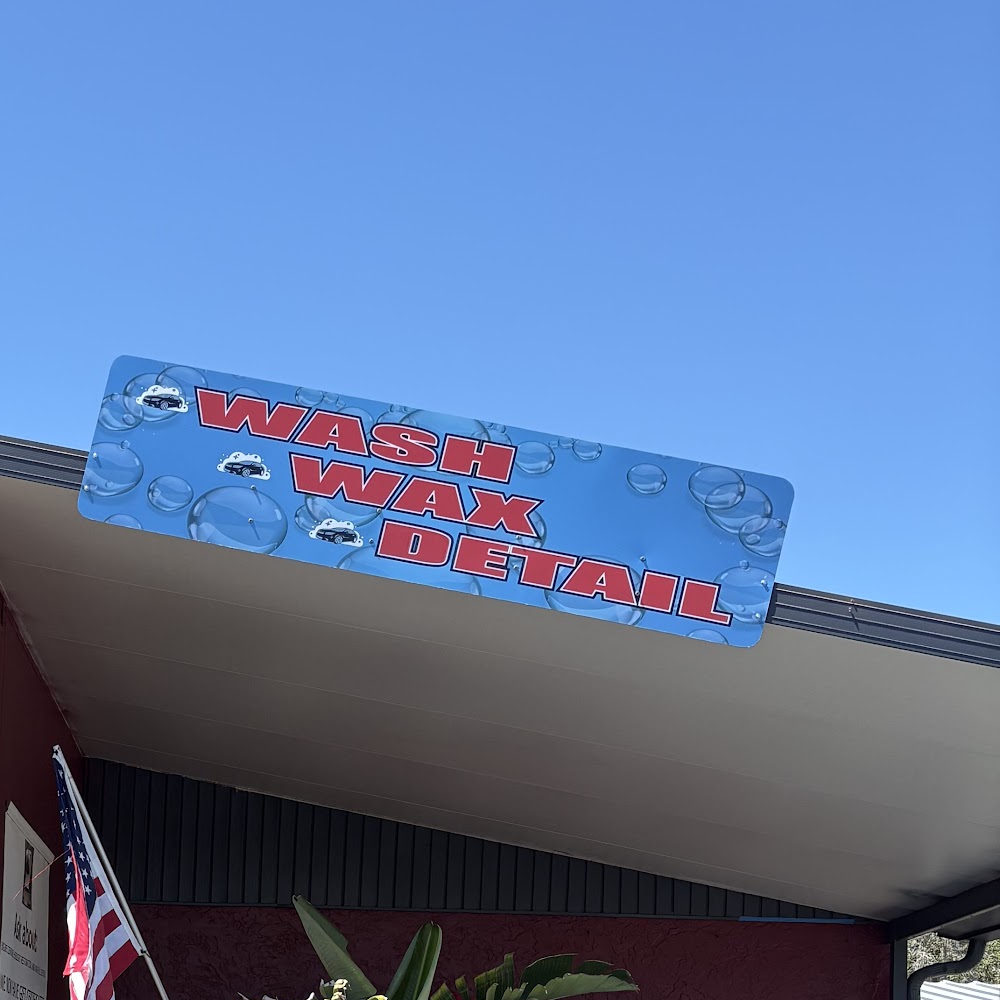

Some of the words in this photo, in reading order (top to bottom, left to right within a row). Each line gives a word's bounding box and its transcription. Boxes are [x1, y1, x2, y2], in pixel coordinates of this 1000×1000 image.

[193, 385, 518, 484] WASH
[288, 452, 545, 538] WAX
[374, 519, 734, 627] DETAIL
